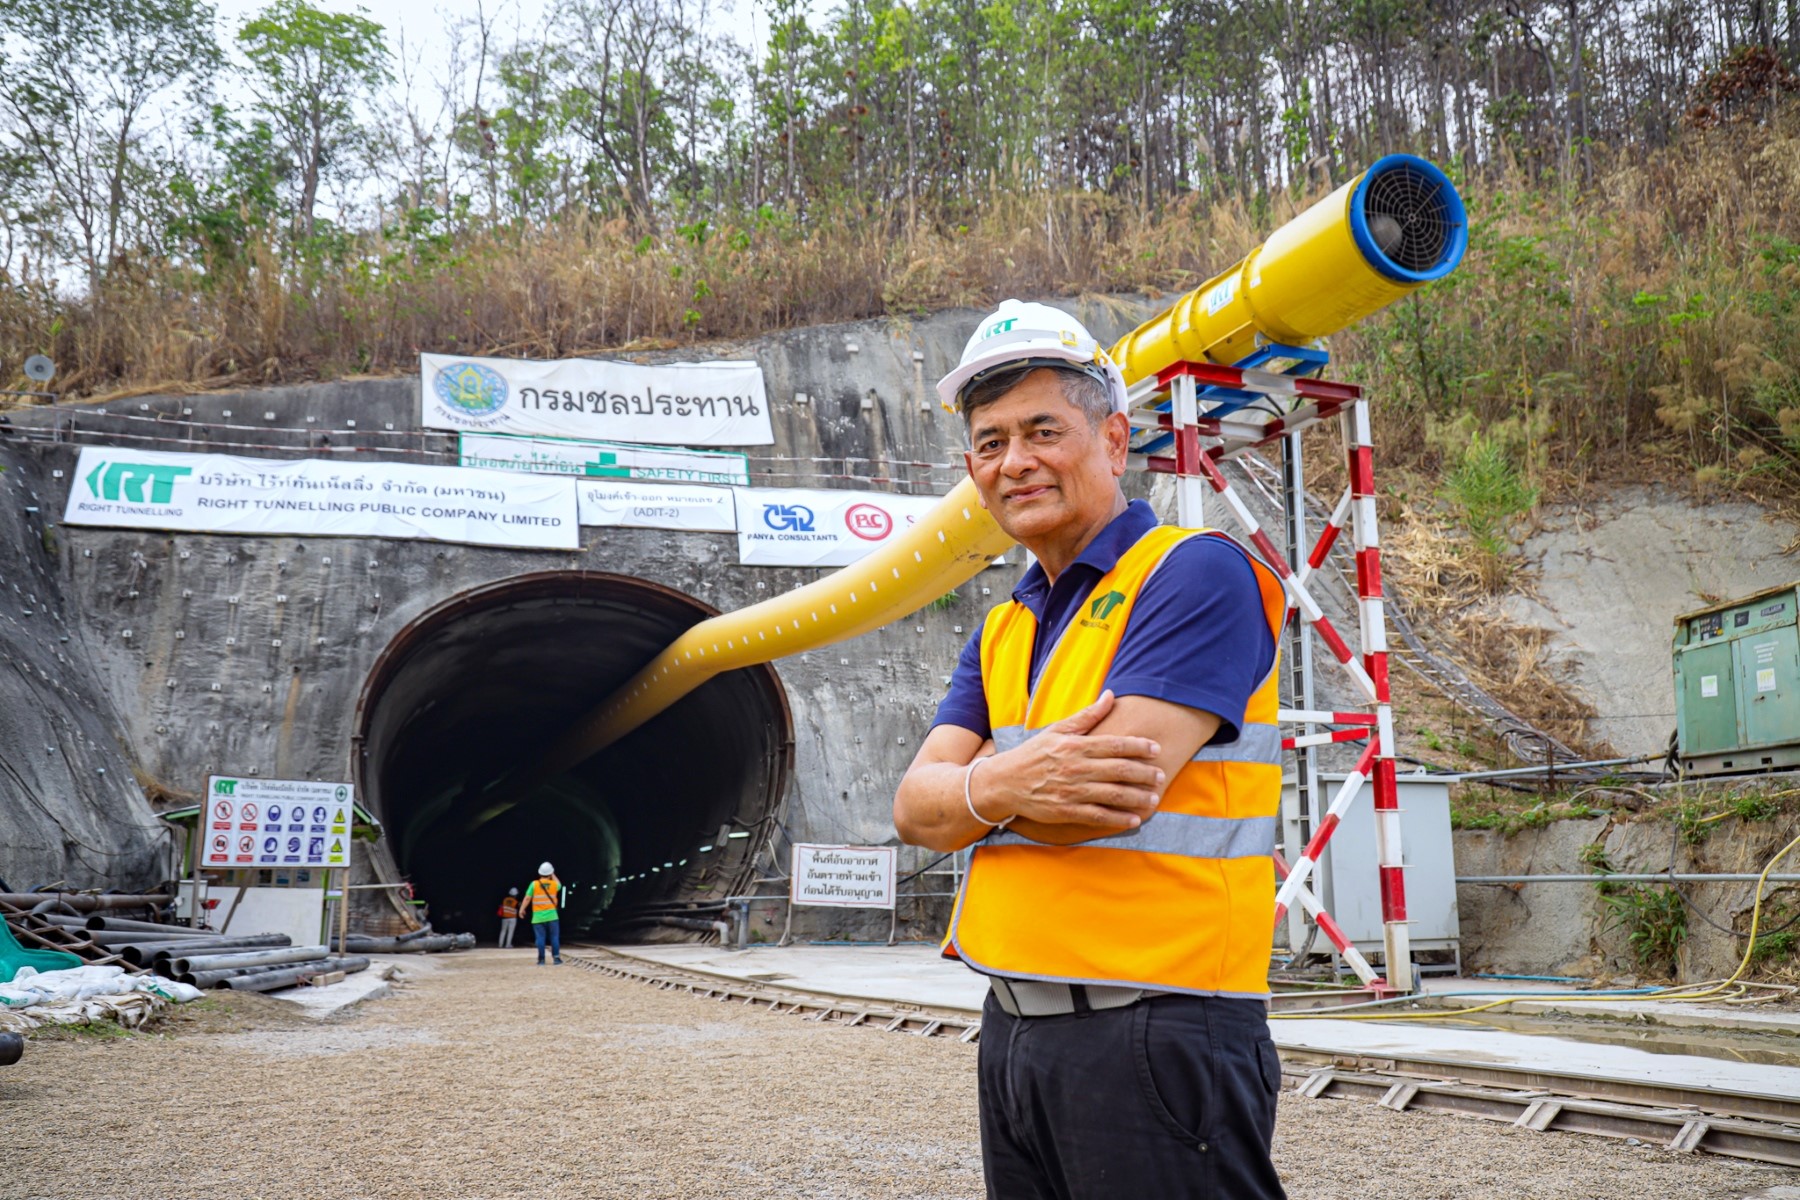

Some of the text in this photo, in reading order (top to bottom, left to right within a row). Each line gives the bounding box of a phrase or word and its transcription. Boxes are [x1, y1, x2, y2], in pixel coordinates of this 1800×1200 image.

[986, 317, 1019, 338] RT
[519, 386, 760, 417] กรมชลประทาน
[636, 467, 741, 485] SAFETY FIRST
[200, 472, 251, 487] บริษัท
[382, 479, 427, 495] จำกัด
[433, 484, 506, 503] (มหาชน)
[78, 502, 184, 517] RIGHT TUNNELLING
[197, 497, 562, 528] RIGHT TUNNELLING PUBLIC COMPANY LIMITED
[633, 506, 680, 518] (ADIT-2)
[747, 532, 839, 542] PANYA CONSULTANTS
[216, 779, 238, 794] RT
[812, 850, 879, 866] พื้นที่อับอากาศ
[807, 868, 883, 882] อันตรายห้ามเข้า
